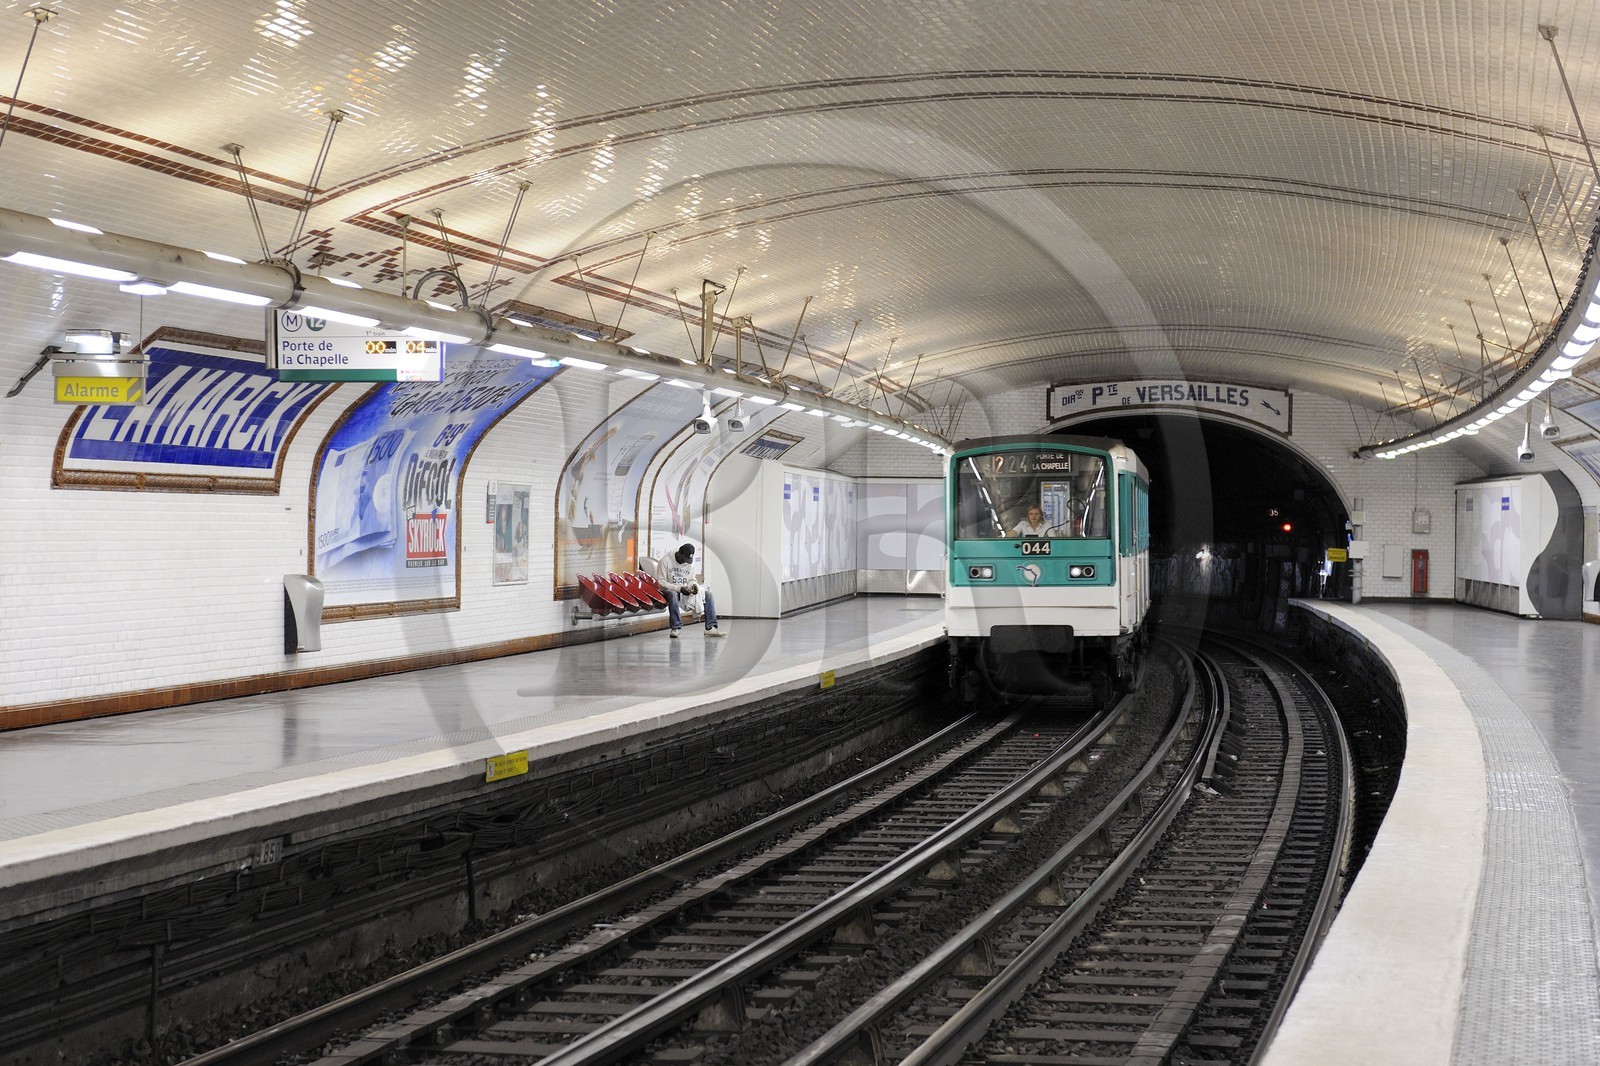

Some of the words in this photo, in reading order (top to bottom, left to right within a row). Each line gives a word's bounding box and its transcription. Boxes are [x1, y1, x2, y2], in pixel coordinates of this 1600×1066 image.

[282, 341, 314, 351] Porte
[322, 341, 333, 351] de
[366, 341, 386, 354] 00
[282, 354, 293, 365] la
[296, 354, 349, 367] Chapelle
[64, 383, 119, 397] Alarme
[1122, 396, 1131, 406] DE
[1136, 384, 1250, 407] VERSAILLES
[365, 433, 404, 466] 1500
[1040, 462, 1069, 470] CHAPELLE
[1269, 508, 1279, 517] 35
[408, 517, 446, 554] SKYROCK
[1021, 542, 1050, 554] 044
